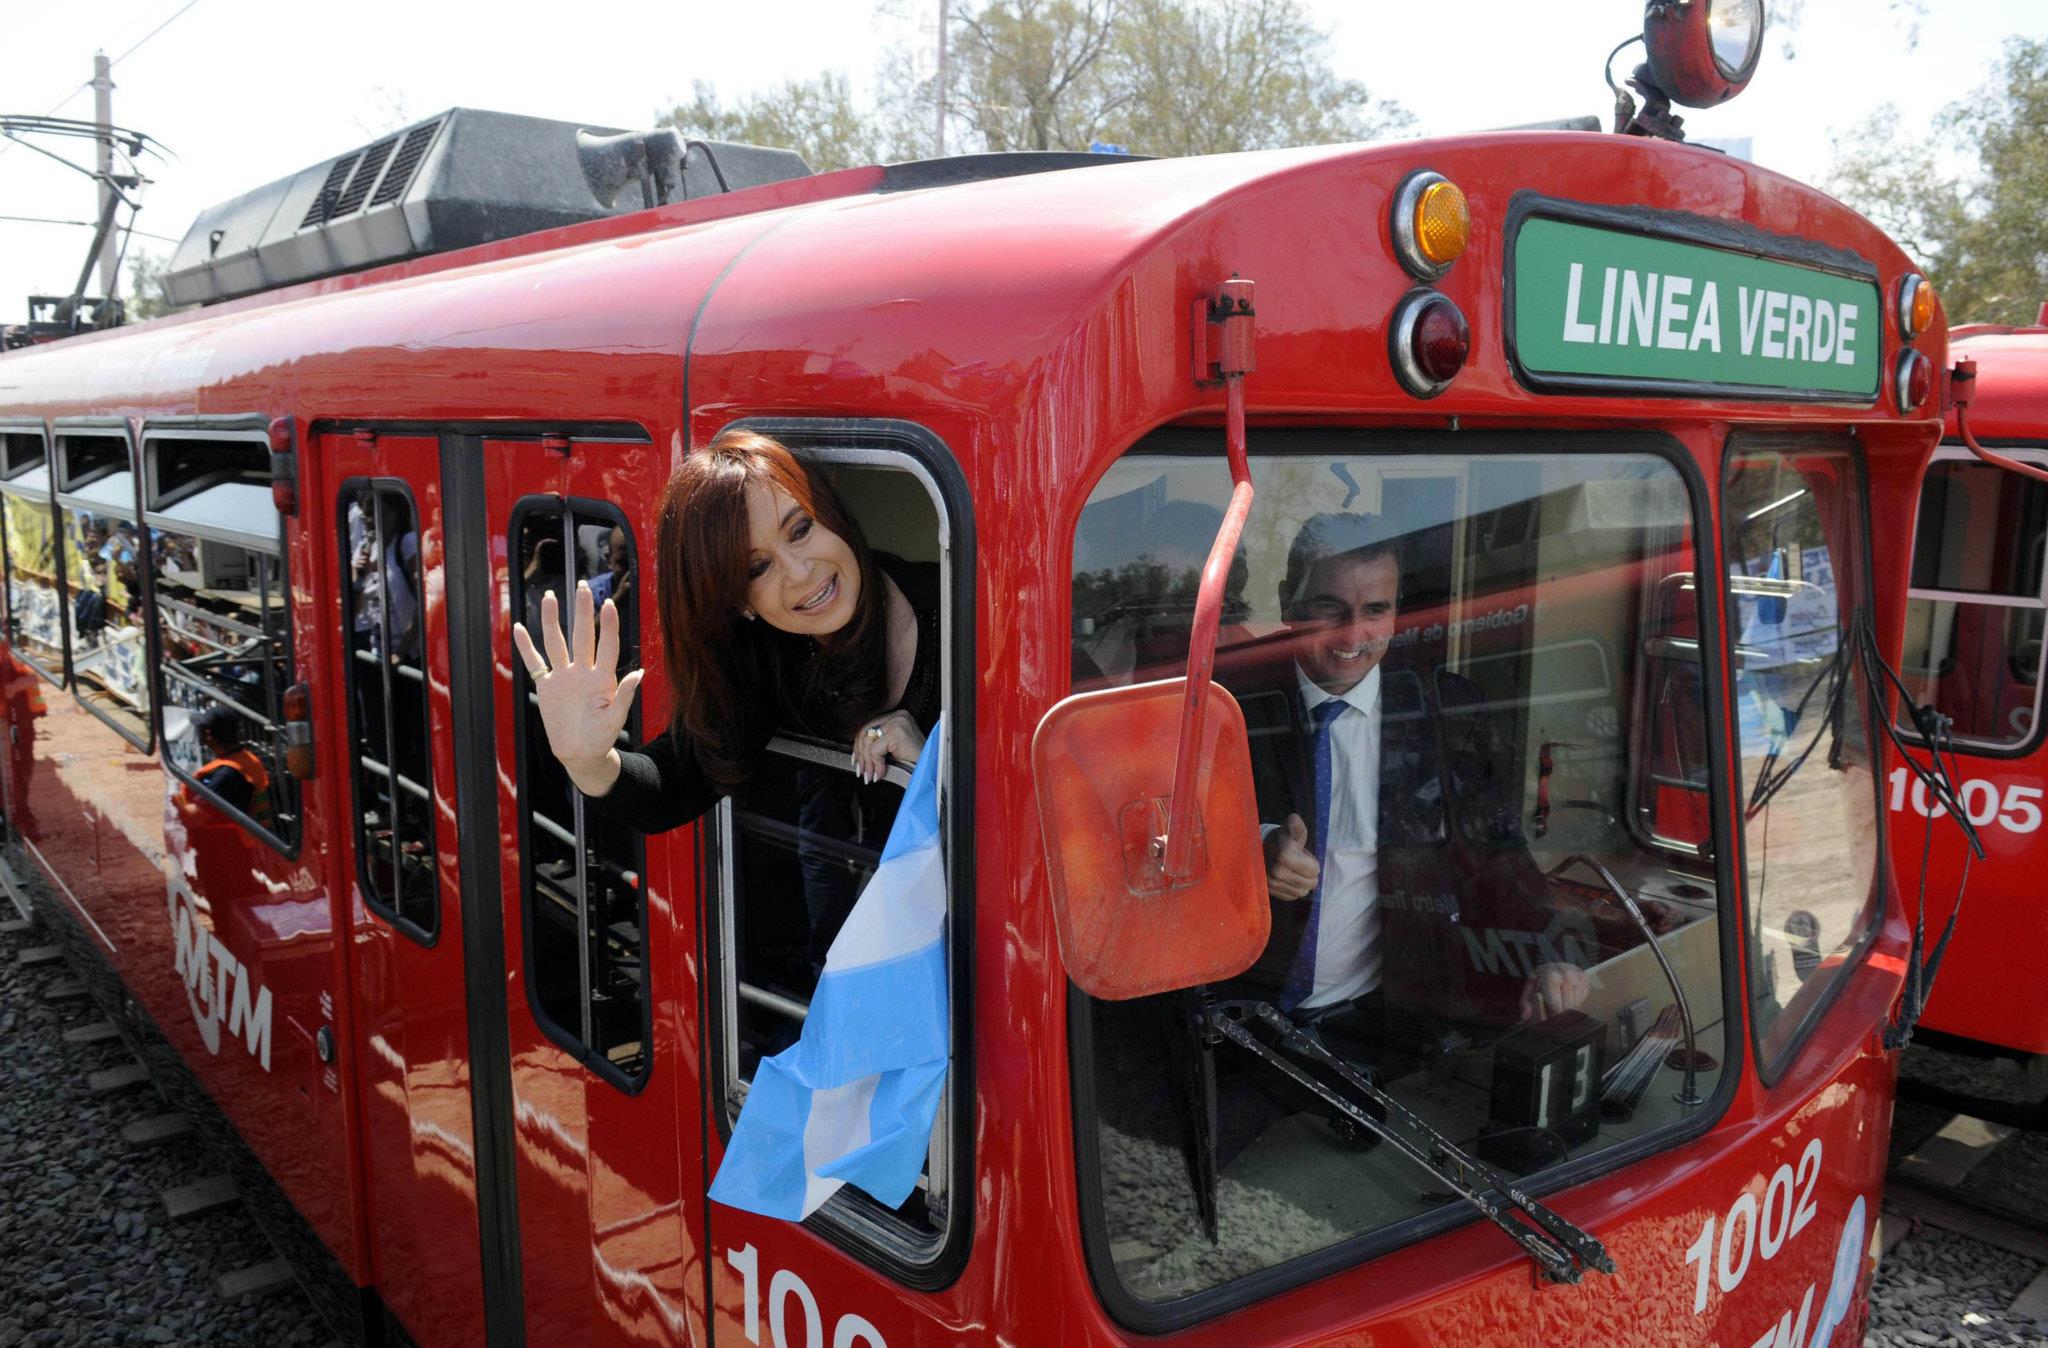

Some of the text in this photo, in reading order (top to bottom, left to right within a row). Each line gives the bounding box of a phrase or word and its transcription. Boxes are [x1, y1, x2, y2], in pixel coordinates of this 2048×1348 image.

[1563, 262, 1858, 365] LINEA VERDE
[1889, 767, 2043, 834] 1005
[175, 906, 273, 1073] MTM
[1686, 1138, 1822, 1315] 1002
